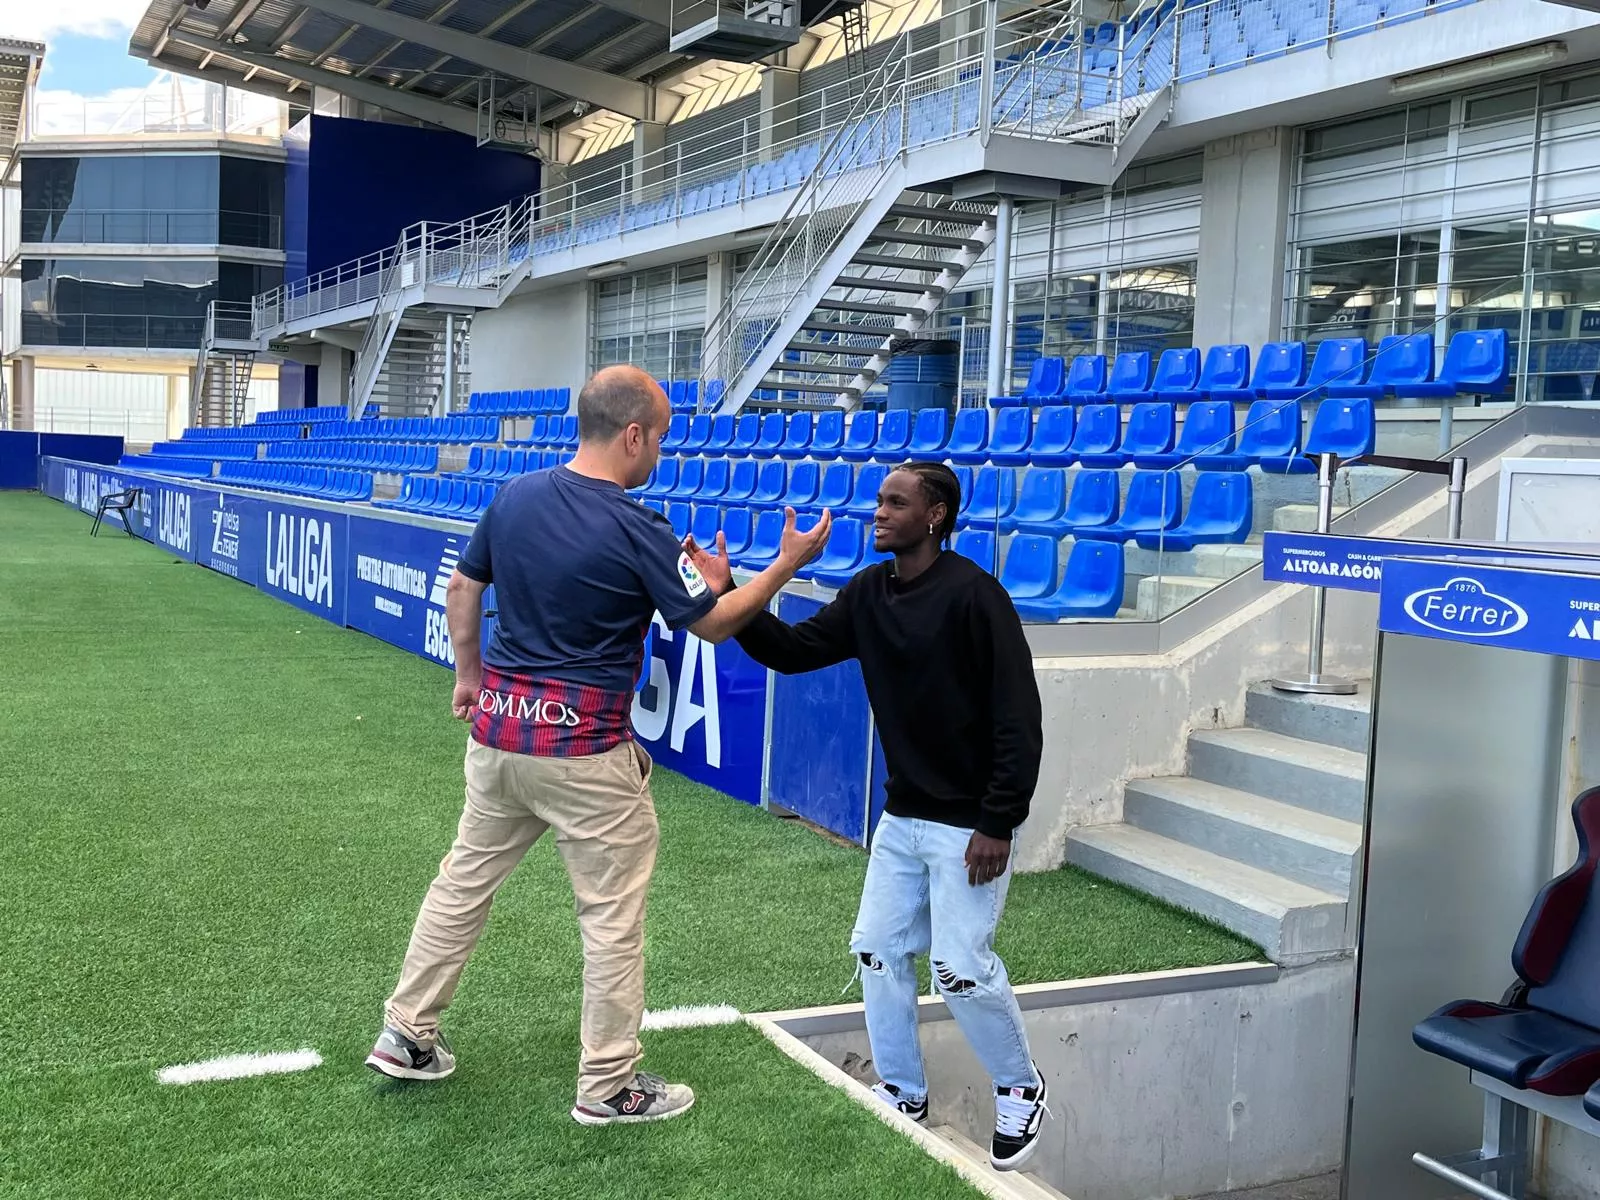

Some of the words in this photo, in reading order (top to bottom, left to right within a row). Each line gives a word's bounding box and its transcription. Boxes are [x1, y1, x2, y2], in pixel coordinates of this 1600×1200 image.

[159, 488, 191, 553] LALIGA
[266, 511, 333, 608] LALIGA
[1282, 548, 1326, 557] SUPERMERCADOS
[357, 554, 382, 586] PUERTAS
[382, 562, 427, 600] AUTOMÁTICAS
[1455, 584, 1477, 593] 1876
[1424, 596, 1513, 626] Ferrer
[479, 689, 580, 727] OMMOS
